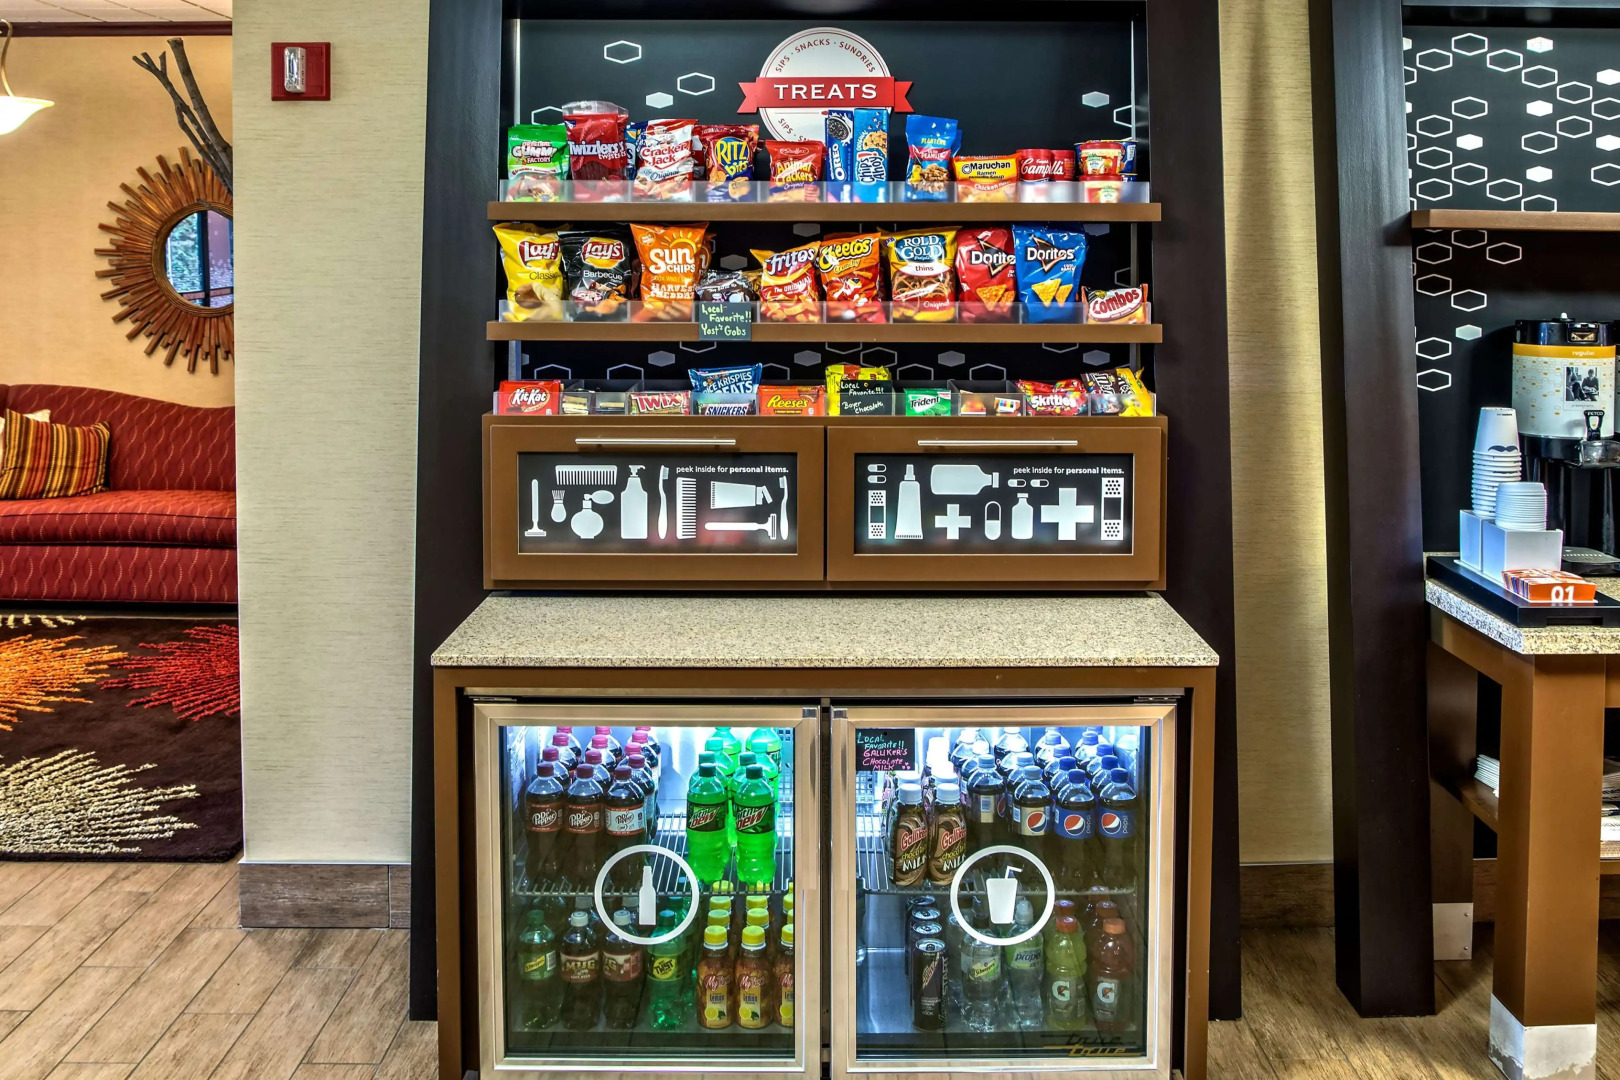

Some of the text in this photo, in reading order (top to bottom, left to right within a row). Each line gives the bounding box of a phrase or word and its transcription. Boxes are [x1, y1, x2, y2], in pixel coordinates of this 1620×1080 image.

[775, 38, 876, 73] SIPS SNACKS SUNDRIES
[773, 83, 877, 100] TREATS
[778, 118, 794, 135] SIPS
[641, 142, 688, 157] Cracker
[716, 140, 748, 165] RITZ
[526, 156, 551, 164] FACTORY
[648, 154, 676, 166] Jack
[776, 157, 813, 174] Animal
[832, 143, 846, 181] OREO
[970, 161, 1011, 170] Maruchan
[724, 160, 749, 176] bits
[859, 157, 876, 185] Chips
[776, 168, 813, 187] Crackers
[974, 183, 999, 191] Chicken
[903, 235, 940, 247] ROLD
[585, 242, 621, 261] Lay's
[819, 239, 872, 273] Cheetos
[900, 244, 942, 259] GOLD
[971, 250, 1016, 265] Dorito
[1027, 247, 1074, 261] Doritos
[649, 247, 696, 274] Sun
[764, 247, 816, 276] Fritos
[833, 259, 861, 274] Crunchy
[915, 264, 934, 272] thins
[583, 269, 623, 281] Barbecue
[665, 264, 696, 274] CHIPS
[701, 303, 723, 314] Local
[1092, 289, 1140, 315] Combos
[724, 325, 747, 336] Gobs
[716, 371, 753, 389] KRISPIES
[511, 388, 547, 405] KitKat
[631, 392, 684, 413] TWIX
[767, 394, 808, 408] Reese's
[908, 396, 940, 408] Trident
[1031, 395, 1077, 408] Skittles
[706, 406, 748, 415] SNICKERS
[676, 465, 789, 474] peek inside for personal items.
[1013, 466, 1125, 475] peek inside for personal items.
[1550, 585, 1576, 602] 01
[534, 813, 556, 826] Pepper
[540, 810, 550, 819] Dr
[571, 815, 593, 828] Pepper
[576, 812, 585, 820] Dr
[616, 814, 633, 825] Pepper
[566, 959, 595, 971] MUG
[706, 975, 718, 991] My
[740, 975, 752, 991] My
[1052, 980, 1070, 1001] G
[1097, 982, 1115, 1003] G
